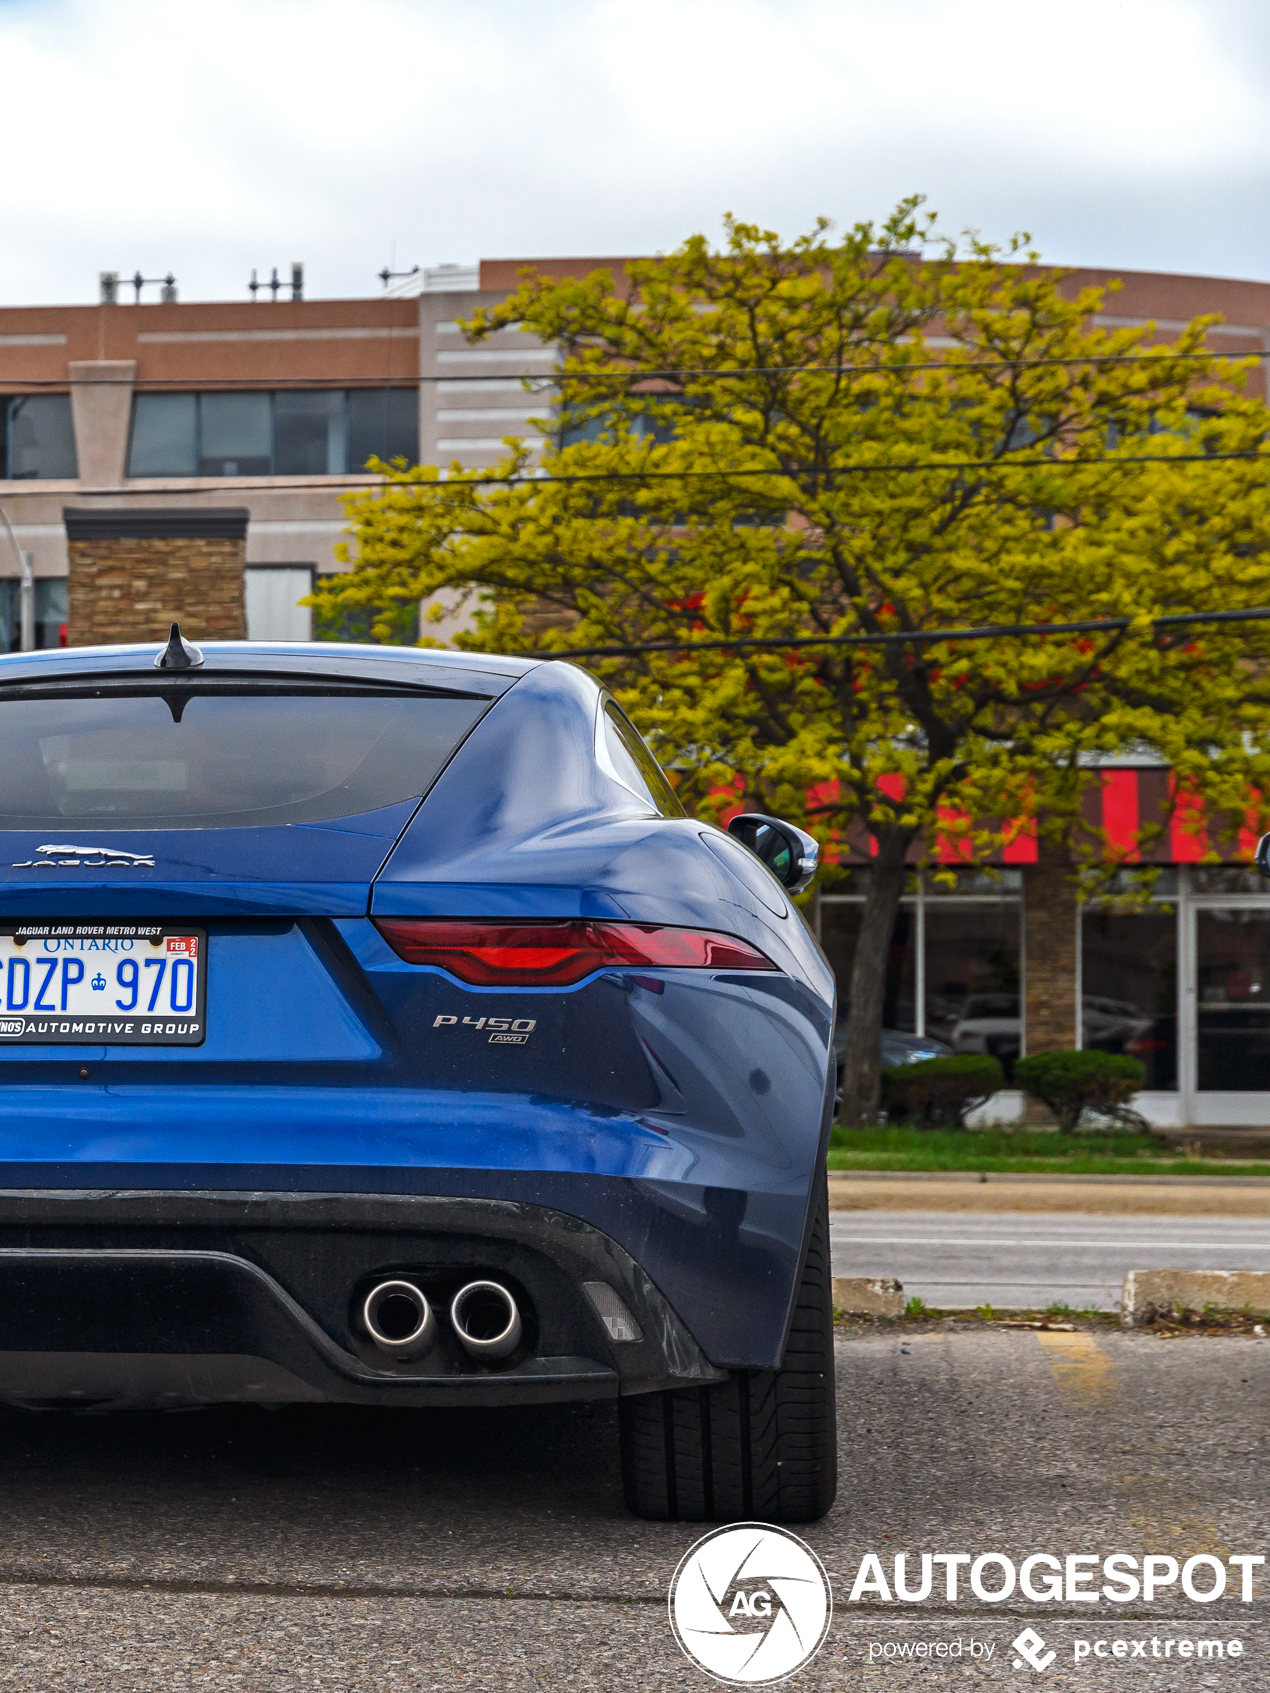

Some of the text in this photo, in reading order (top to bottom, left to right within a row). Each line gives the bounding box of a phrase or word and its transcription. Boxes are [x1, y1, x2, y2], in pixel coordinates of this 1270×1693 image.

[15, 926, 162, 936] JAGUAR LAND ROVER METRO WEST
[43, 938, 135, 954] ONTARIO
[170, 941, 186, 951] FEB
[115, 958, 195, 1012] 970
[25, 1022, 134, 1034] AUTOMOTIVE
[141, 1023, 200, 1035] GROUP
[432, 1015, 537, 1032] P450
